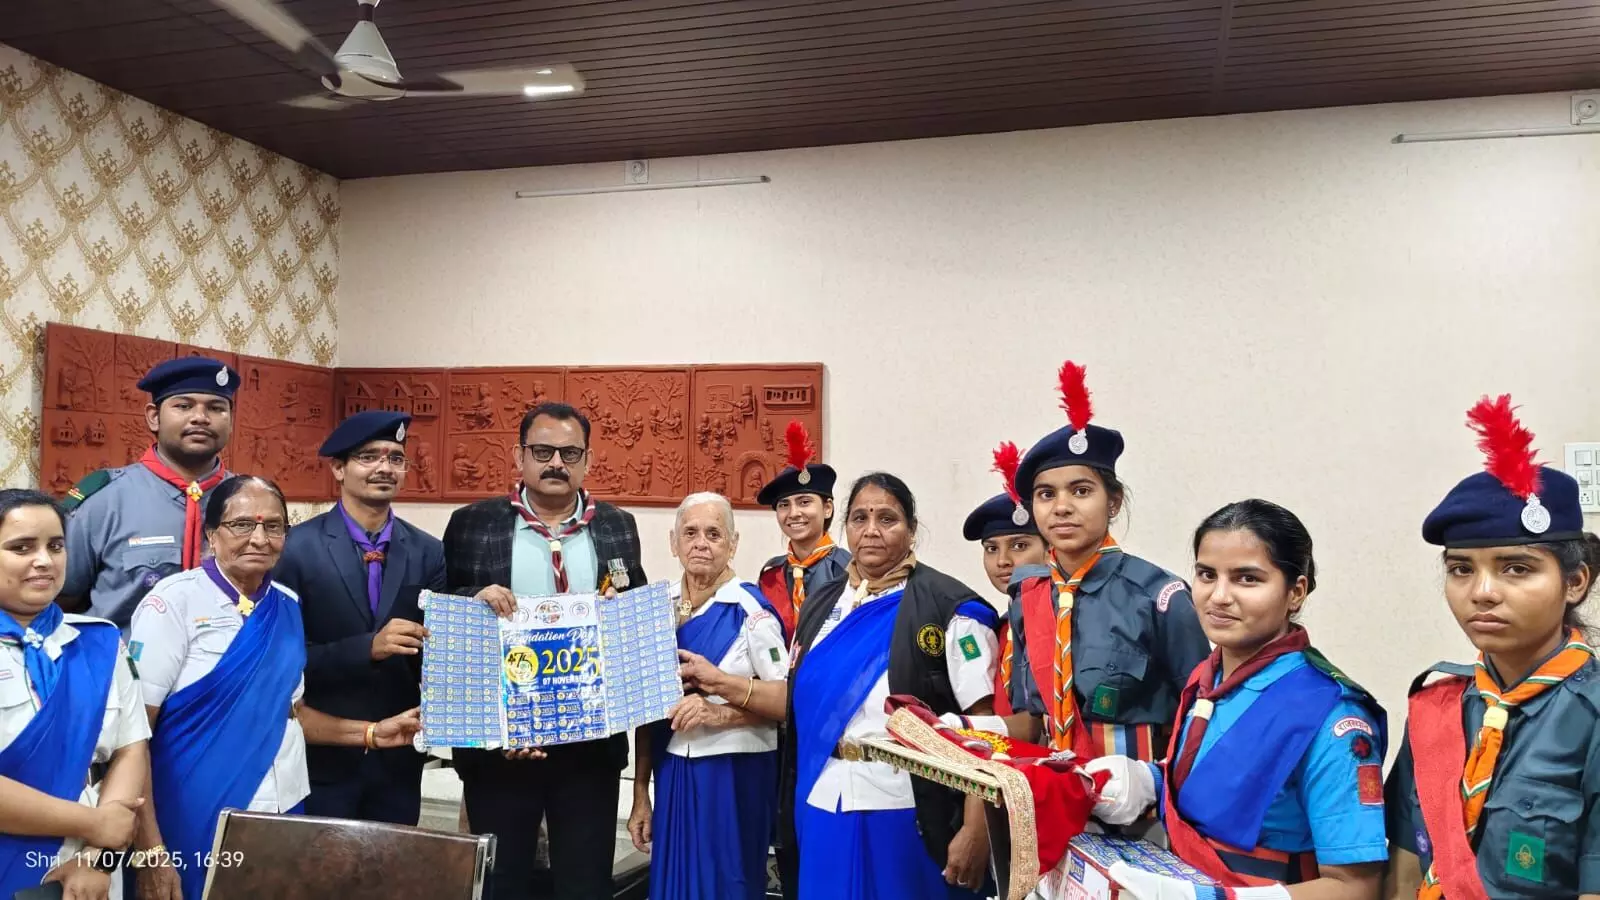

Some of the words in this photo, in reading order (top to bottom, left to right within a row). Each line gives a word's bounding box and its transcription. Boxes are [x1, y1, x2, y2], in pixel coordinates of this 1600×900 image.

[541, 646, 599, 678] 2025
[542, 677, 550, 686] 07
[552, 672, 589, 685] NOVEMBE
